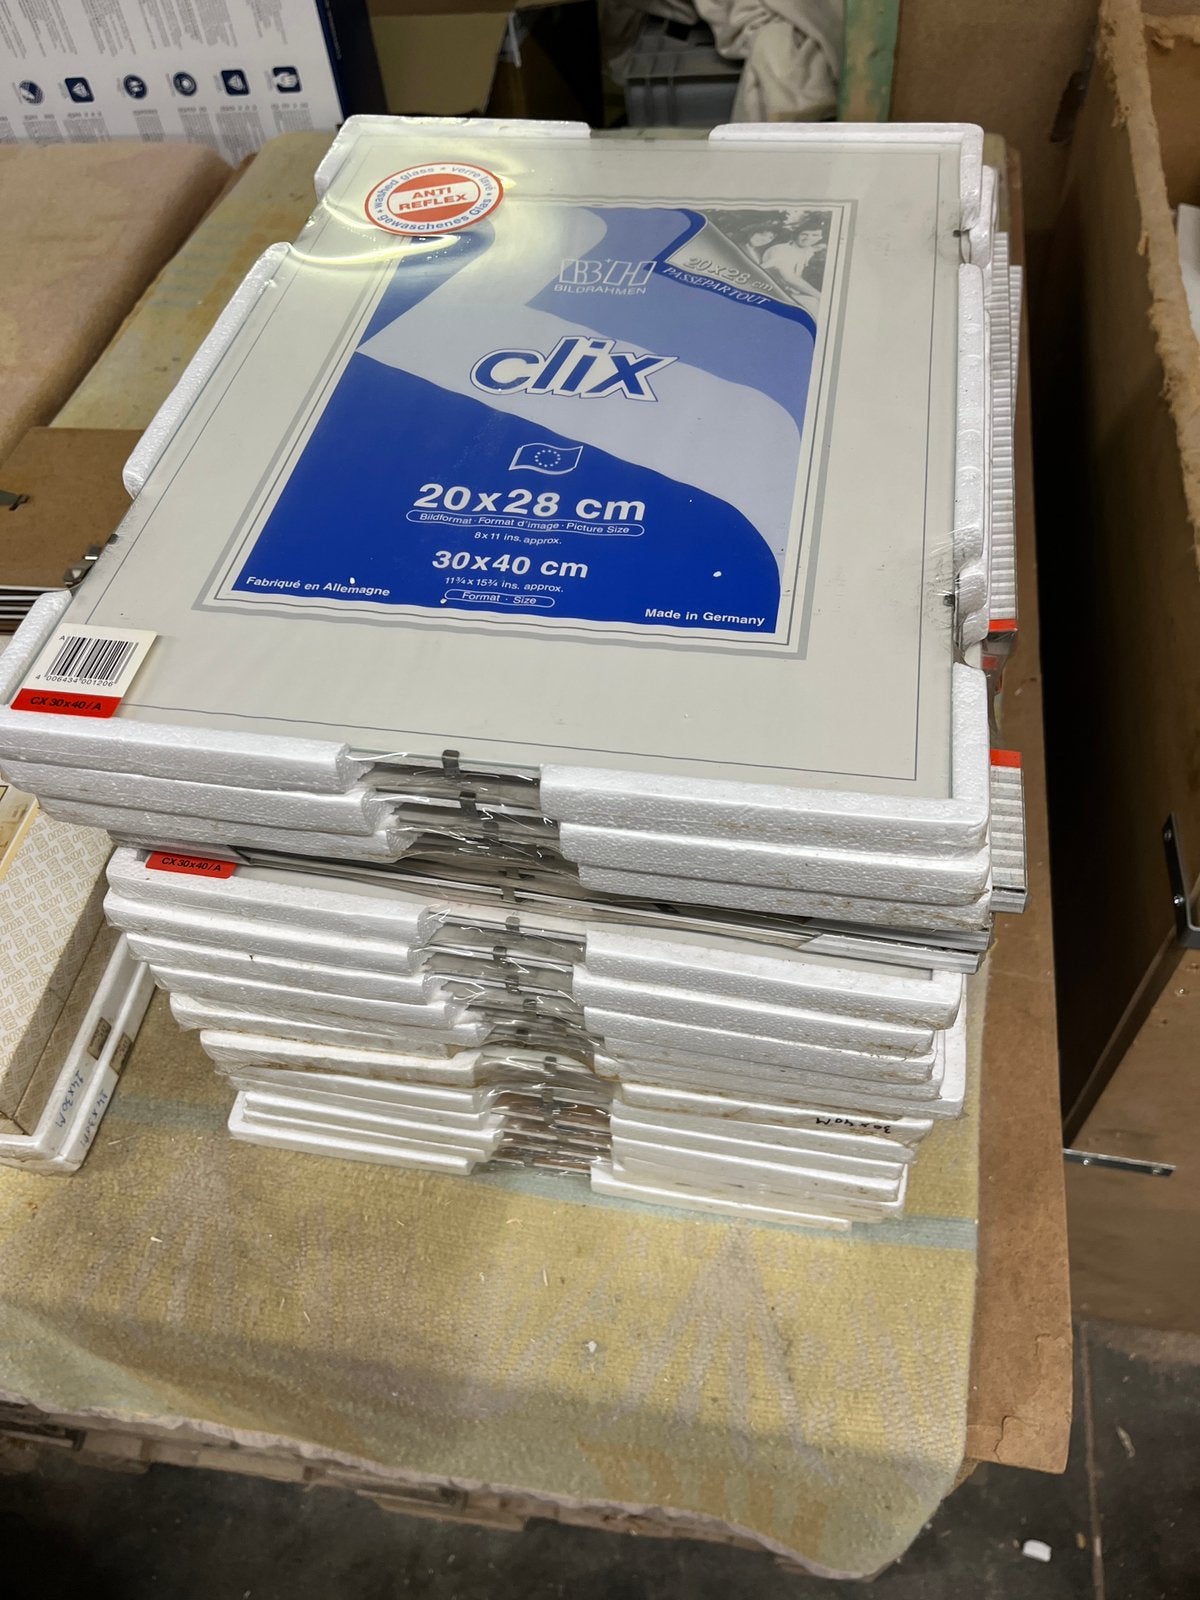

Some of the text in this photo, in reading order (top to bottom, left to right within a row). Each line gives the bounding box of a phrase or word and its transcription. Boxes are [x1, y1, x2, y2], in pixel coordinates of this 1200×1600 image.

[374, 179, 399, 209] washed
[400, 167, 434, 181] glass
[451, 166, 482, 178] verre
[412, 187, 452, 199] ANTI
[399, 194, 468, 211] REFLEX
[377, 198, 492, 231] gewaschenes Glas
[553, 284, 647, 295] BILDRAHMEN
[662, 267, 772, 305] PASSEPARTOUT
[751, 280, 774, 292] cm
[469, 336, 679, 402] clix
[412, 482, 647, 521] 20x28 cm
[419, 512, 630, 534] Bildformat Format d'image Picture Size
[503, 533, 522, 543] ins.
[523, 536, 562, 546] approx.
[432, 550, 589, 579] 30x40 cm
[246, 576, 391, 597] Fabriqué en Allemagne
[501, 579, 520, 590] ins.
[523, 582, 564, 594] approx.
[462, 591, 537, 605] Format Size
[645, 608, 765, 627] Made in Germany
[30, 696, 47, 706] CX
[161, 857, 176, 866] CX
